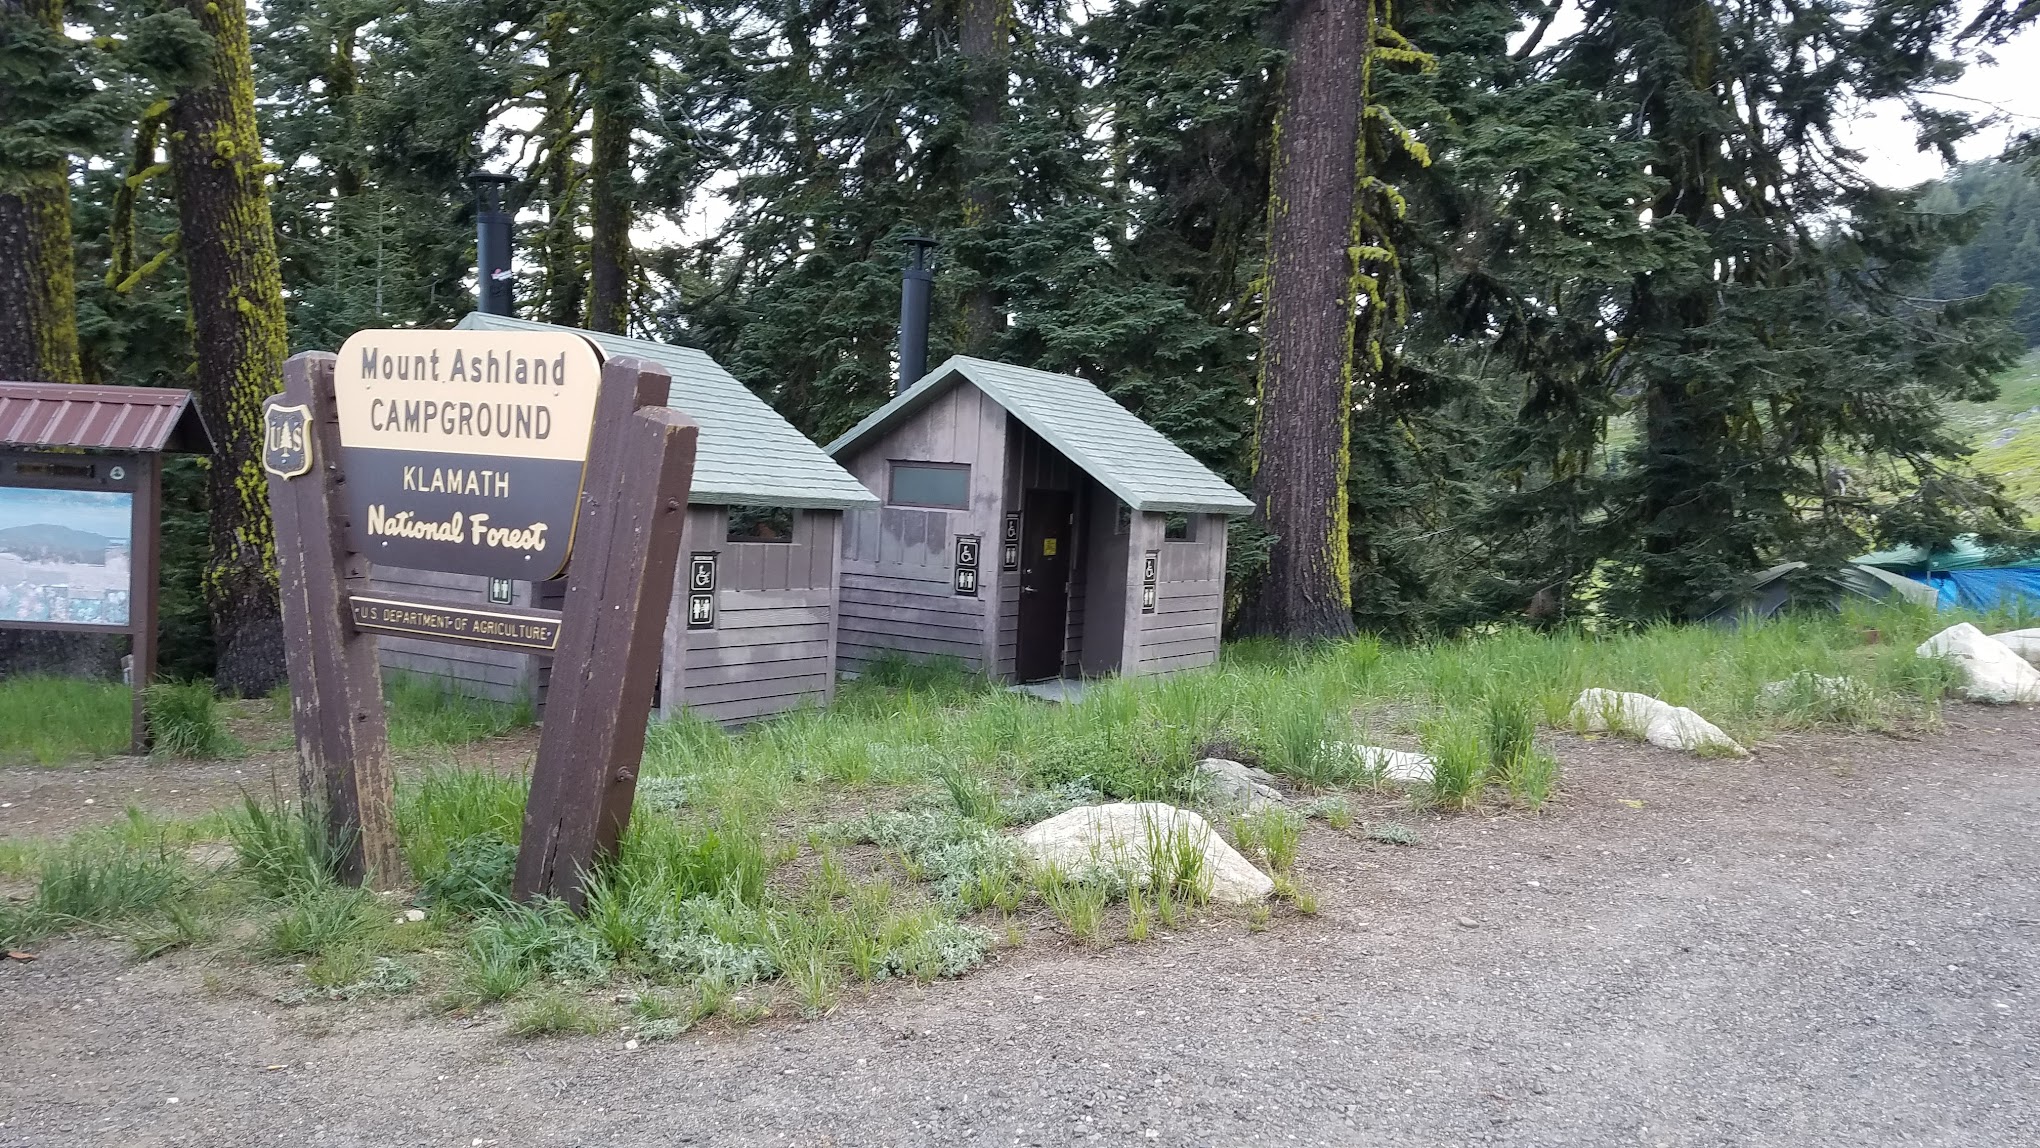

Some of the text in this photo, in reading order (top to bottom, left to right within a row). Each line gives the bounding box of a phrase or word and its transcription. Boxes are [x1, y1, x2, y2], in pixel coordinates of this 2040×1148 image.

[361, 347, 565, 386] Mount Ashland
[371, 398, 551, 440] CAMPGROUND
[403, 465, 509, 498] KLAMATH
[368, 504, 548, 551] National Forest
[383, 608, 449, 628] DEPARTMENT
[454, 617, 468, 631] OF
[472, 619, 547, 641] AGRICULTURE
